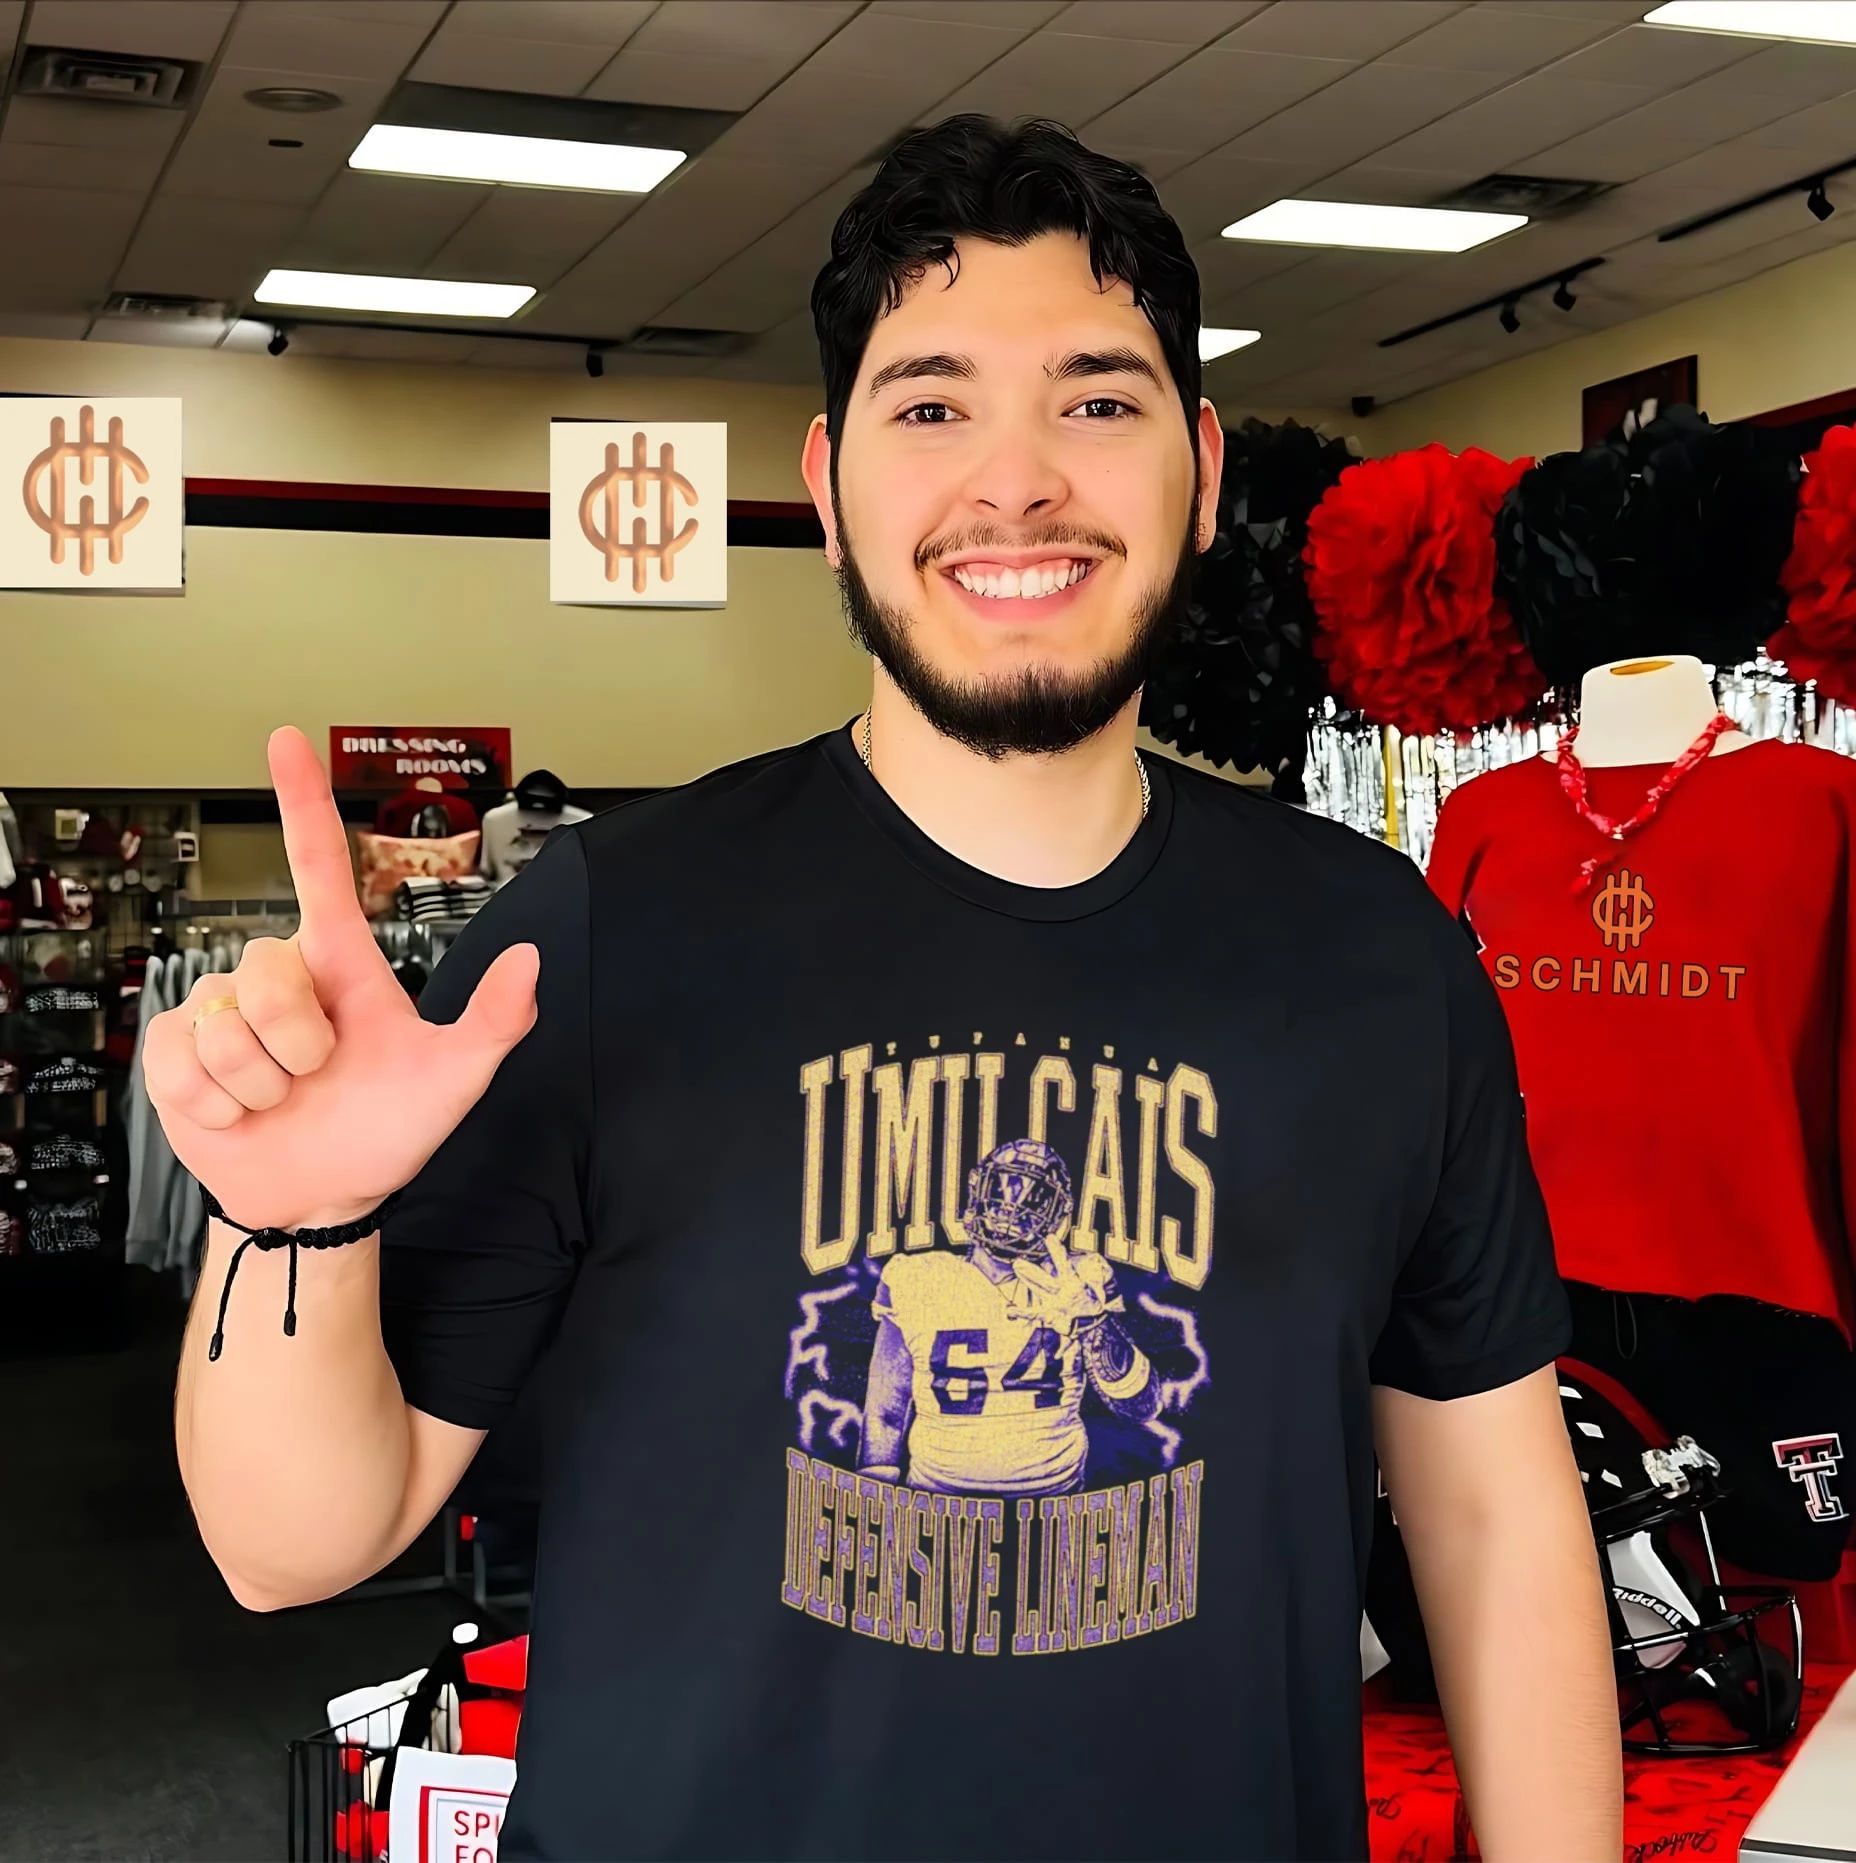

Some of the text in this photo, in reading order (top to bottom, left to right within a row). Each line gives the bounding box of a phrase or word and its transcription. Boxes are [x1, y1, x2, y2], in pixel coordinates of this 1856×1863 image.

[396, 758, 487, 775] ROOMS
[1494, 954, 1746, 1000] SCHMIDT
[782, 1447, 1204, 1656] DEFENSIVE LINEMAN
